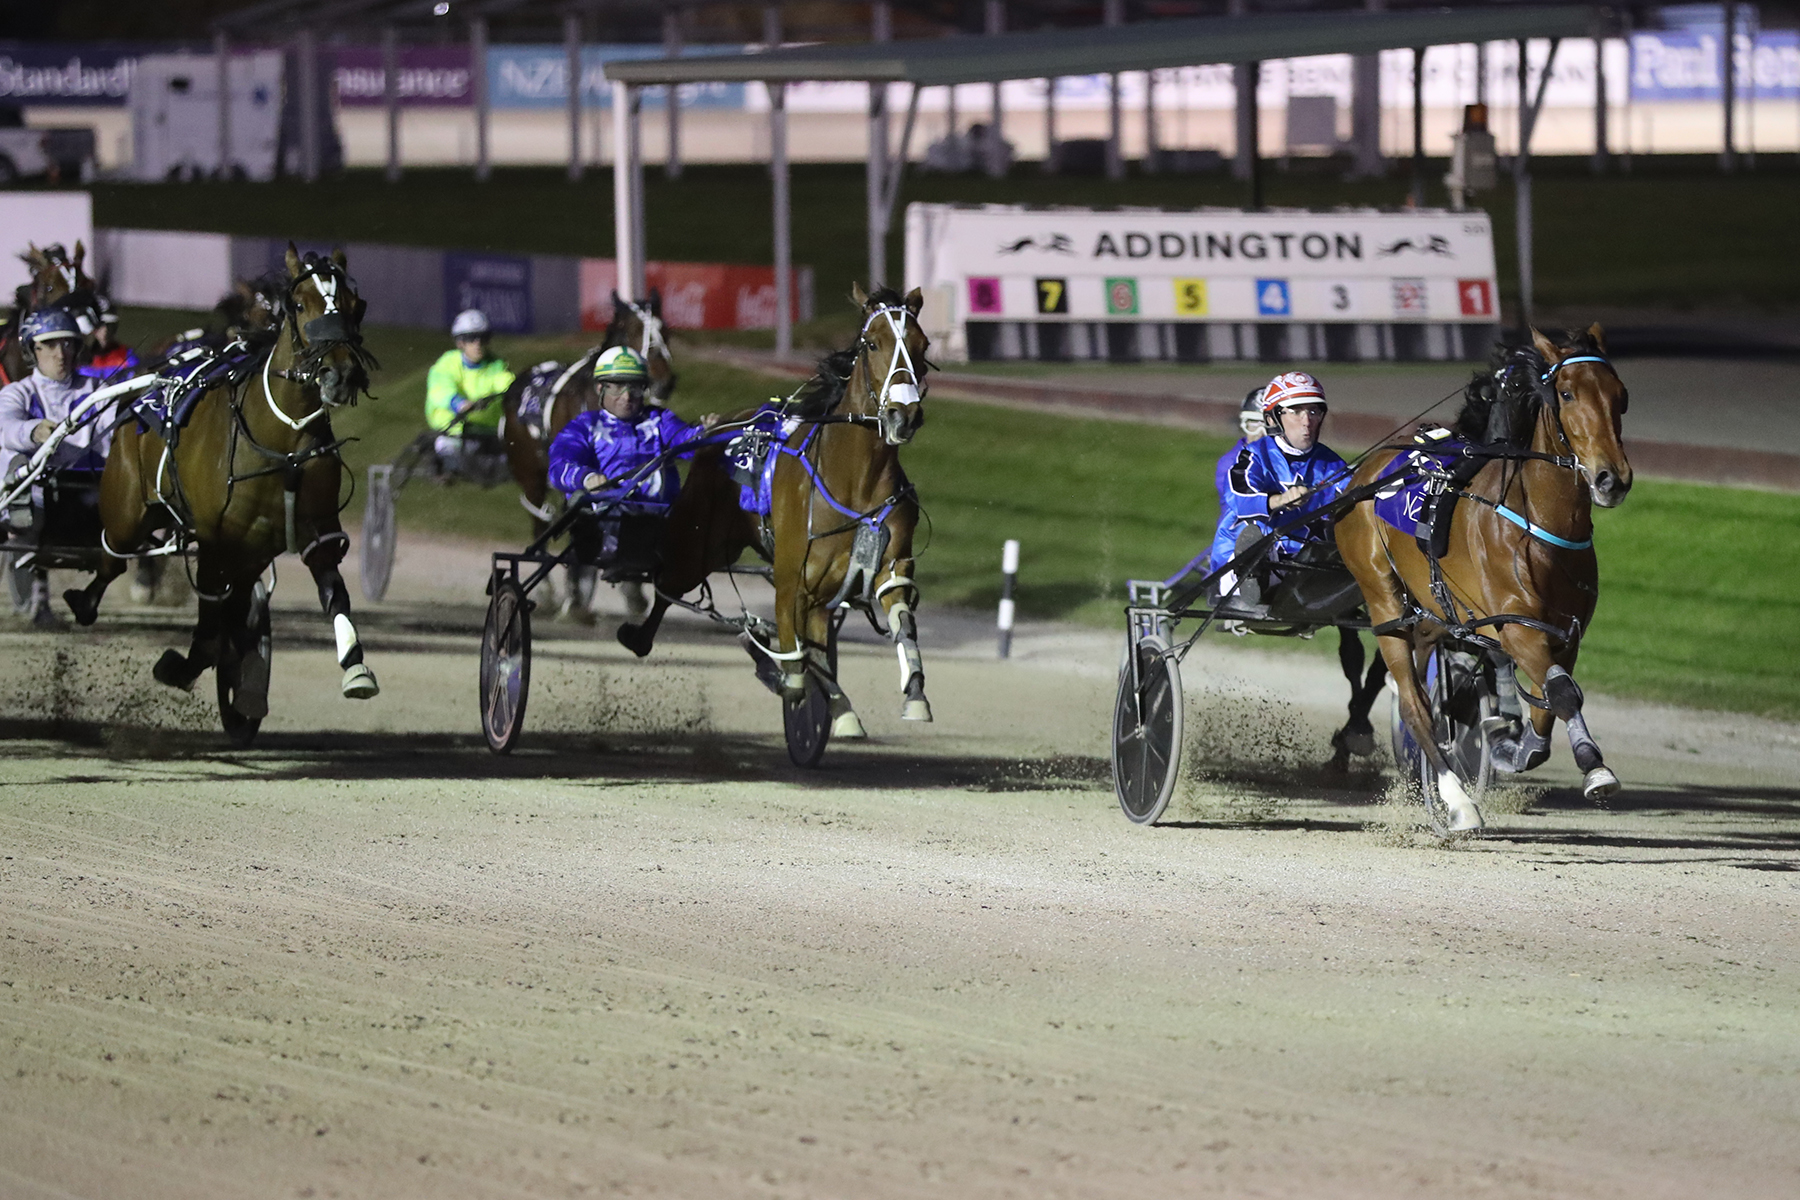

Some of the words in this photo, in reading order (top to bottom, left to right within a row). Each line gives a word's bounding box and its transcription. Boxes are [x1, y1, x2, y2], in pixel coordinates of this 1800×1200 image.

[1094, 232, 1363, 260] ADDINGTON
[1040, 282, 1063, 311] 7
[1111, 283, 1132, 310] 6
[1183, 284, 1200, 309] 5
[1263, 283, 1285, 311] 4
[1332, 285, 1350, 311] 3
[1465, 284, 1484, 313] 1
